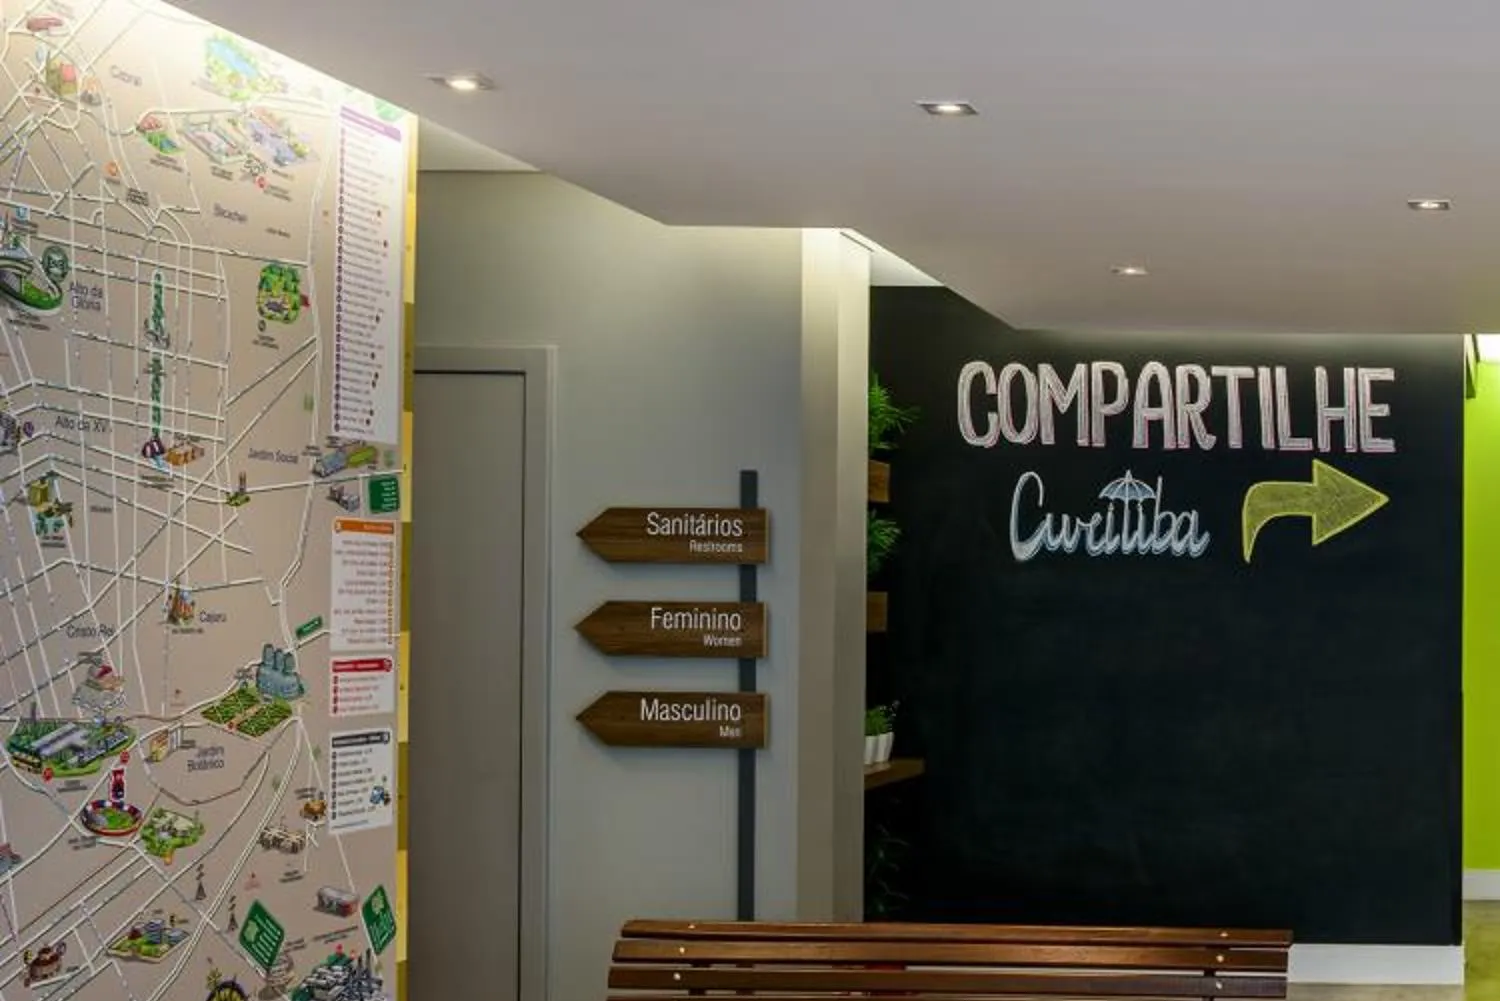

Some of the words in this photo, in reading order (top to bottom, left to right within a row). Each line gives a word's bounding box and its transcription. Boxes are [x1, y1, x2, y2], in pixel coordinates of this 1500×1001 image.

[956, 360, 1398, 453] COMPARTILHE
[646, 511, 744, 537] Sanitários
[1008, 470, 1212, 563] Curitiba
[689, 539, 743, 553] Restrooms
[650, 607, 742, 631] Feminino
[703, 634, 742, 647] Women
[640, 698, 742, 721] Masculino
[719, 725, 741, 738] Men
